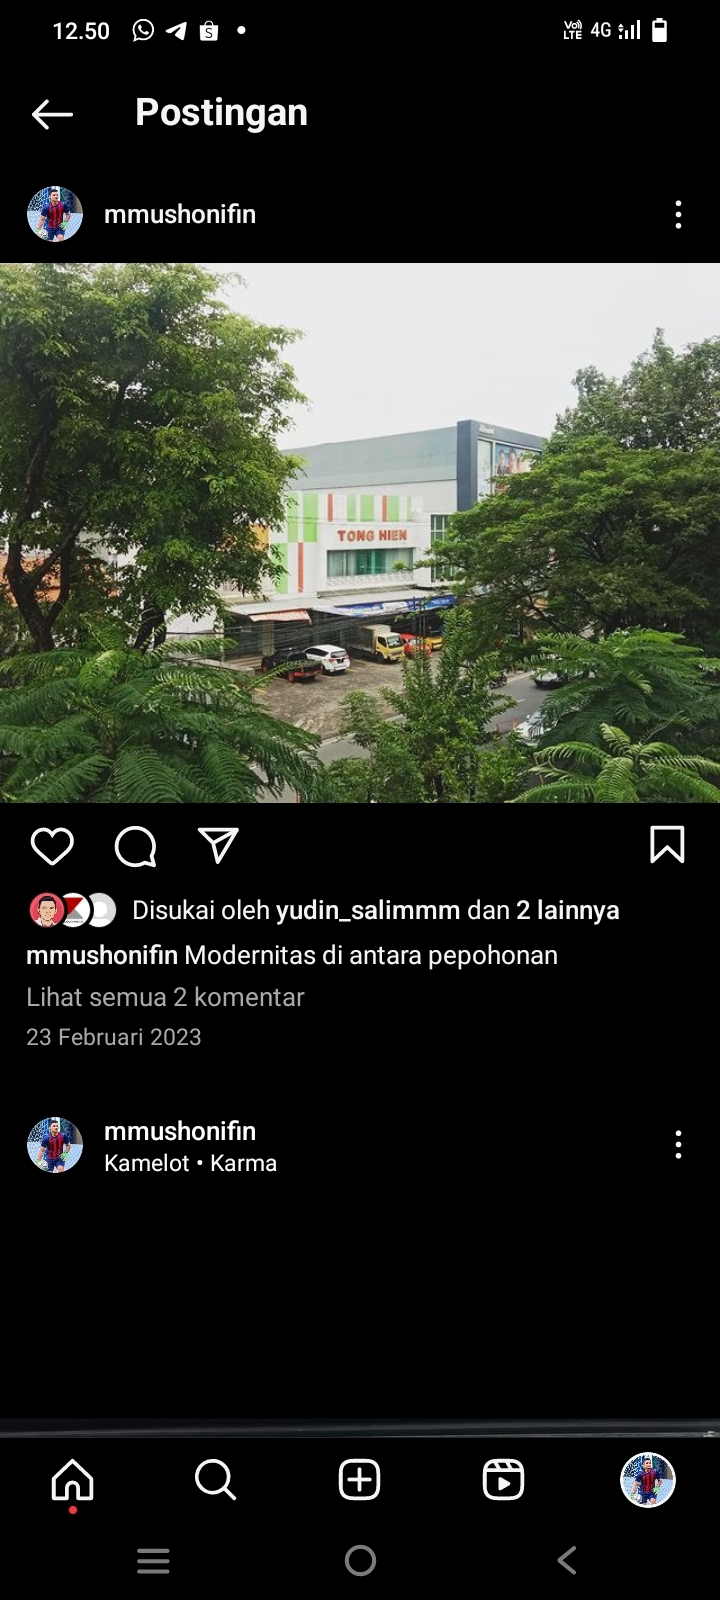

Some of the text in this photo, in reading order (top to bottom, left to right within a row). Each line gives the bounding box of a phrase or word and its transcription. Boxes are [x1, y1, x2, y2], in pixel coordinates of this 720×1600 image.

[53, 21, 110, 41] 12.50
[563, 30, 583, 40] LTE
[590, 21, 612, 38] 4G
[137, 97, 308, 133] Postingan
[104, 202, 256, 225] mmushonifin
[337, 530, 407, 542] TONG HIEN
[133, 899, 620, 926] Disukai oleh yudin_salimmm dan 2 lainnya
[27, 944, 558, 971] mmushonifin Modernitas di antara pepohonan
[27, 985, 306, 1007] Lihat semua 2 komentar
[27, 1028, 202, 1046] 23 Februari 2023
[104, 1119, 256, 1142] mmushonifin
[105, 1153, 278, 1173] Kamelot Karma
